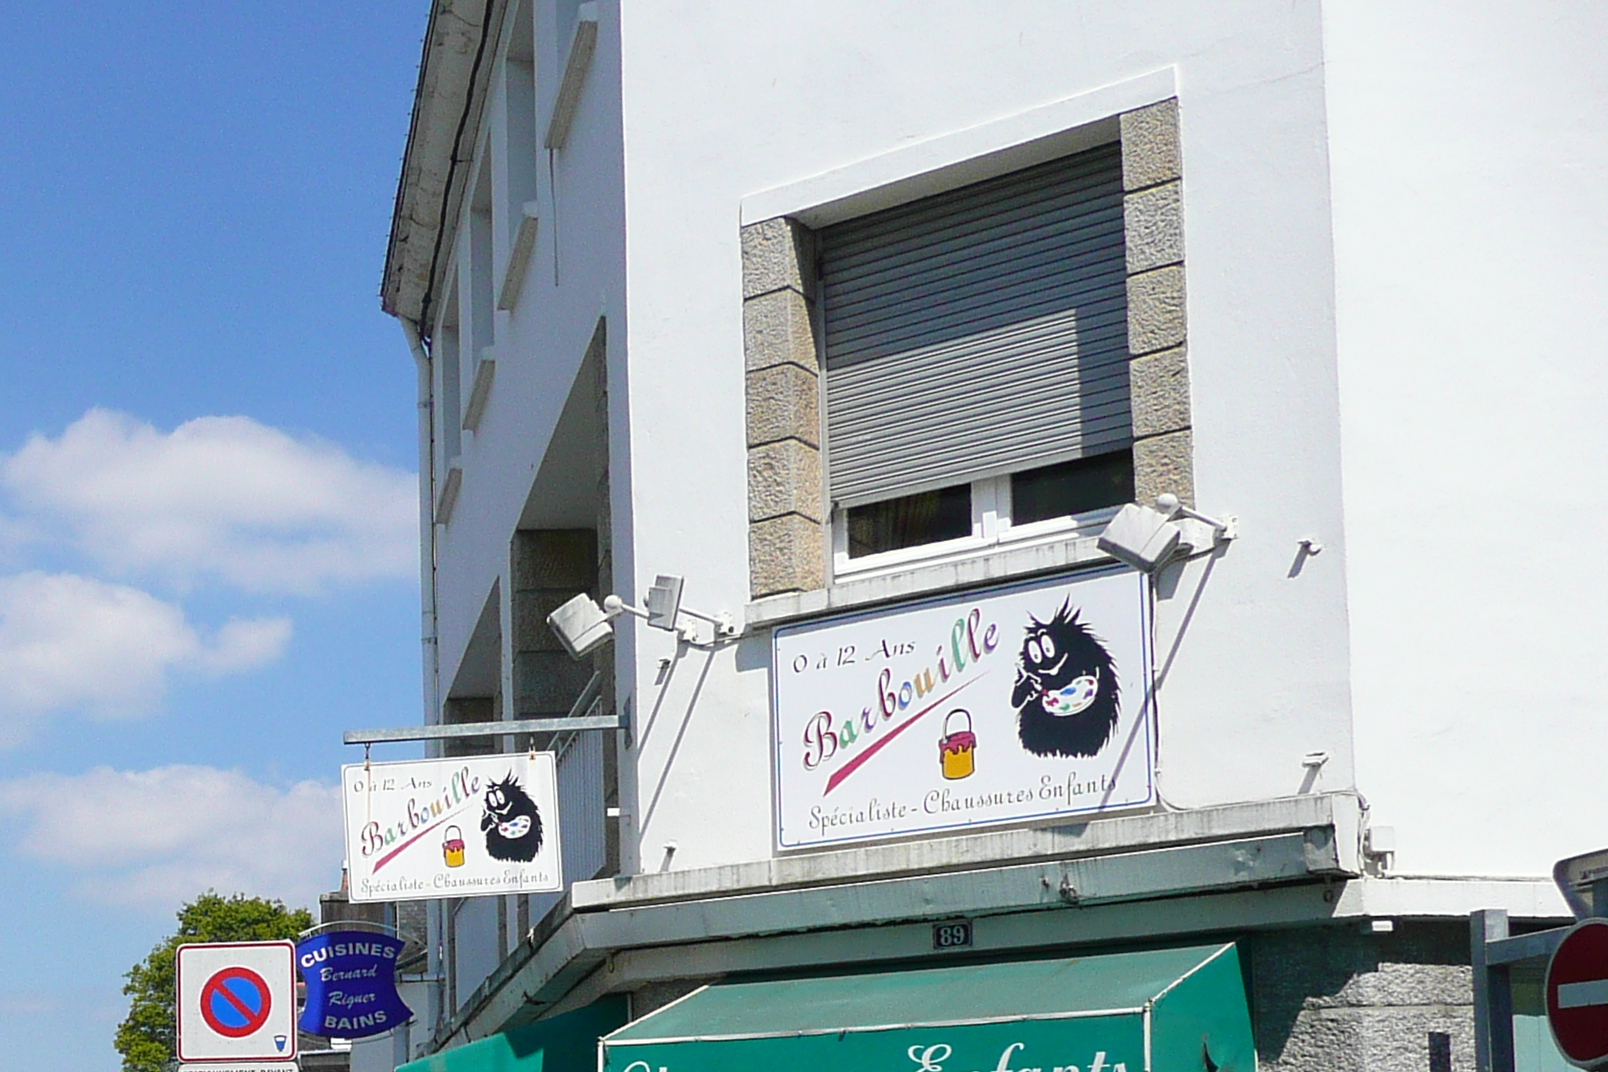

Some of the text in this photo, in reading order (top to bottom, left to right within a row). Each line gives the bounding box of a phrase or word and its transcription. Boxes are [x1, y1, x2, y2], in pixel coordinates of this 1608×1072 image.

[816, 652, 827, 670] à
[837, 645, 856, 666] 12
[865, 639, 916, 661] Ans
[803, 608, 1000, 771] Barbouille
[383, 778, 395, 791] 12
[400, 777, 432, 791] Ans
[923, 788, 1034, 815] Chaussures
[1039, 771, 1117, 806] Enfants
[361, 766, 481, 858] Barbouille
[503, 869, 549, 889] Enfants
[940, 926, 965, 947] 89
[300, 942, 396, 968] CUISINES
[320, 963, 378, 982] Bernard
[324, 1010, 387, 1030] BAINS
